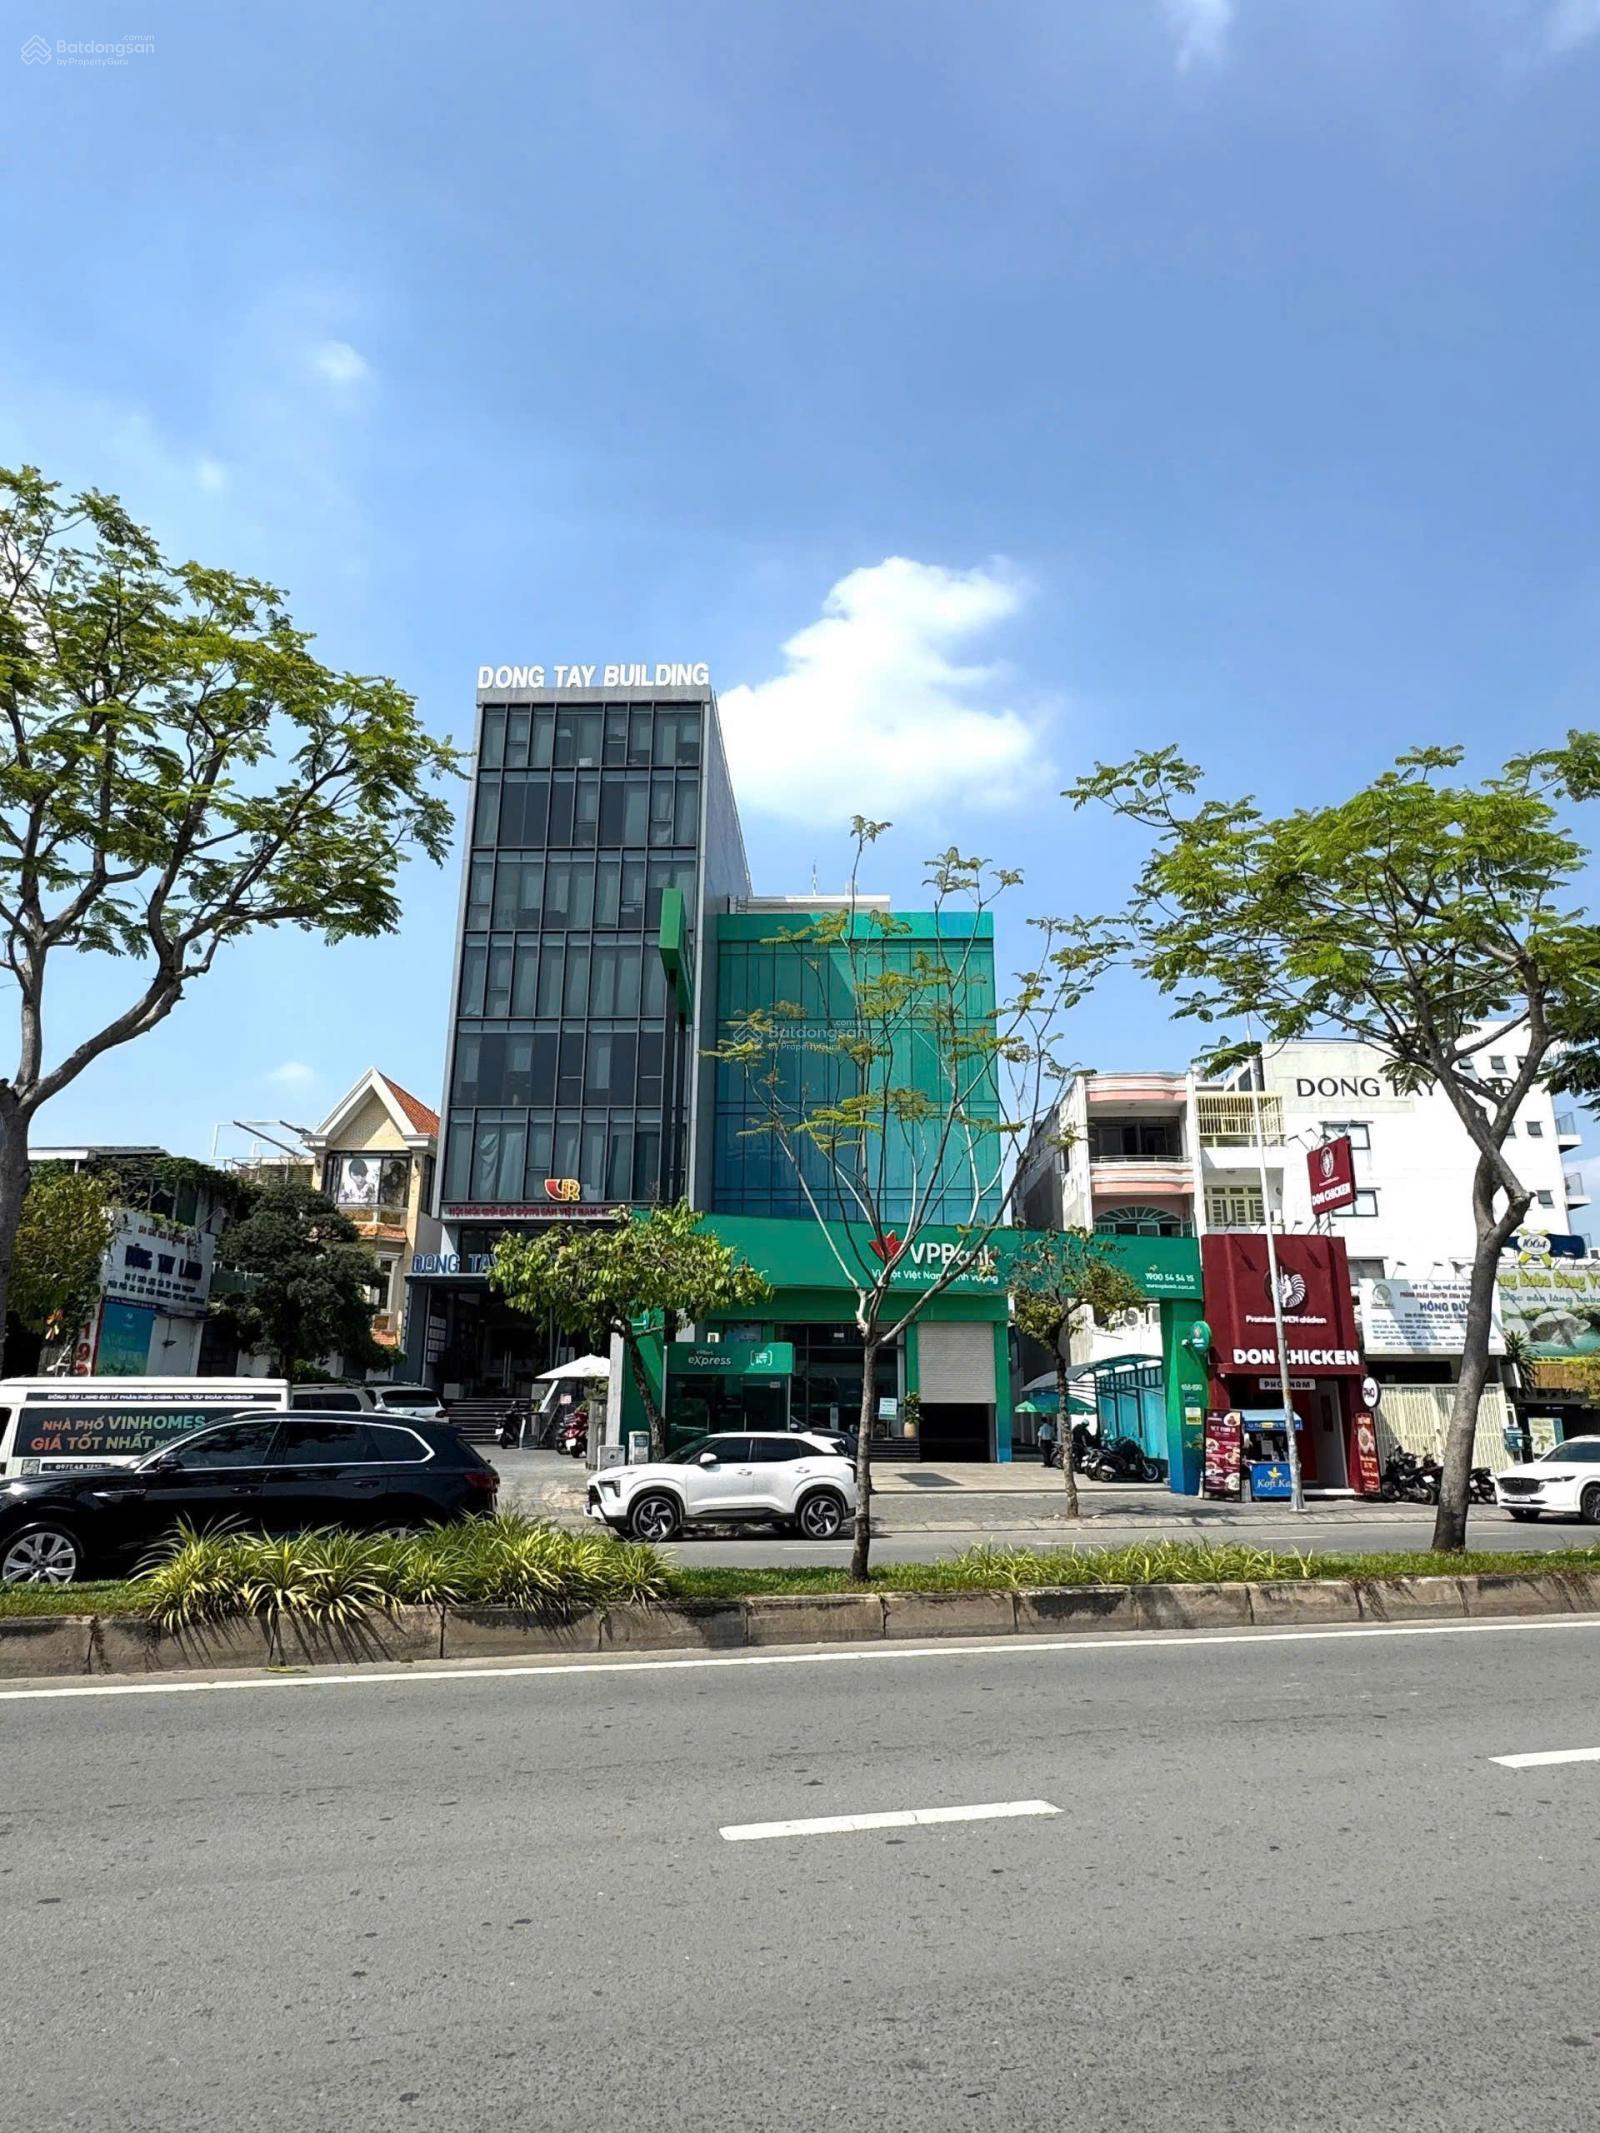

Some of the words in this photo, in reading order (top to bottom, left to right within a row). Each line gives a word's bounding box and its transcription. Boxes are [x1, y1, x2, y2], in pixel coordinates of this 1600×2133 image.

[478, 665, 545, 688] DONG
[554, 665, 596, 687] TAY
[604, 663, 709, 687] BUILDING
[1296, 1078, 1380, 1097] DONG
[903, 1269, 921, 1281] Việt
[1145, 1273, 1164, 1281] 1900
[1165, 1273, 1175, 1281] 54
[1175, 1274, 1186, 1282] 54
[688, 1354, 732, 1367] eXpress
[1233, 1349, 1275, 1364] DON
[42, 1417, 72, 1431] NHÀ
[77, 1414, 104, 1430] PHỐ
[108, 1415, 206, 1430] VINHOMES
[31, 1433, 62, 1451] GIÁ
[67, 1431, 102, 1450] TỐT
[106, 1431, 153, 1450] NHẤT
